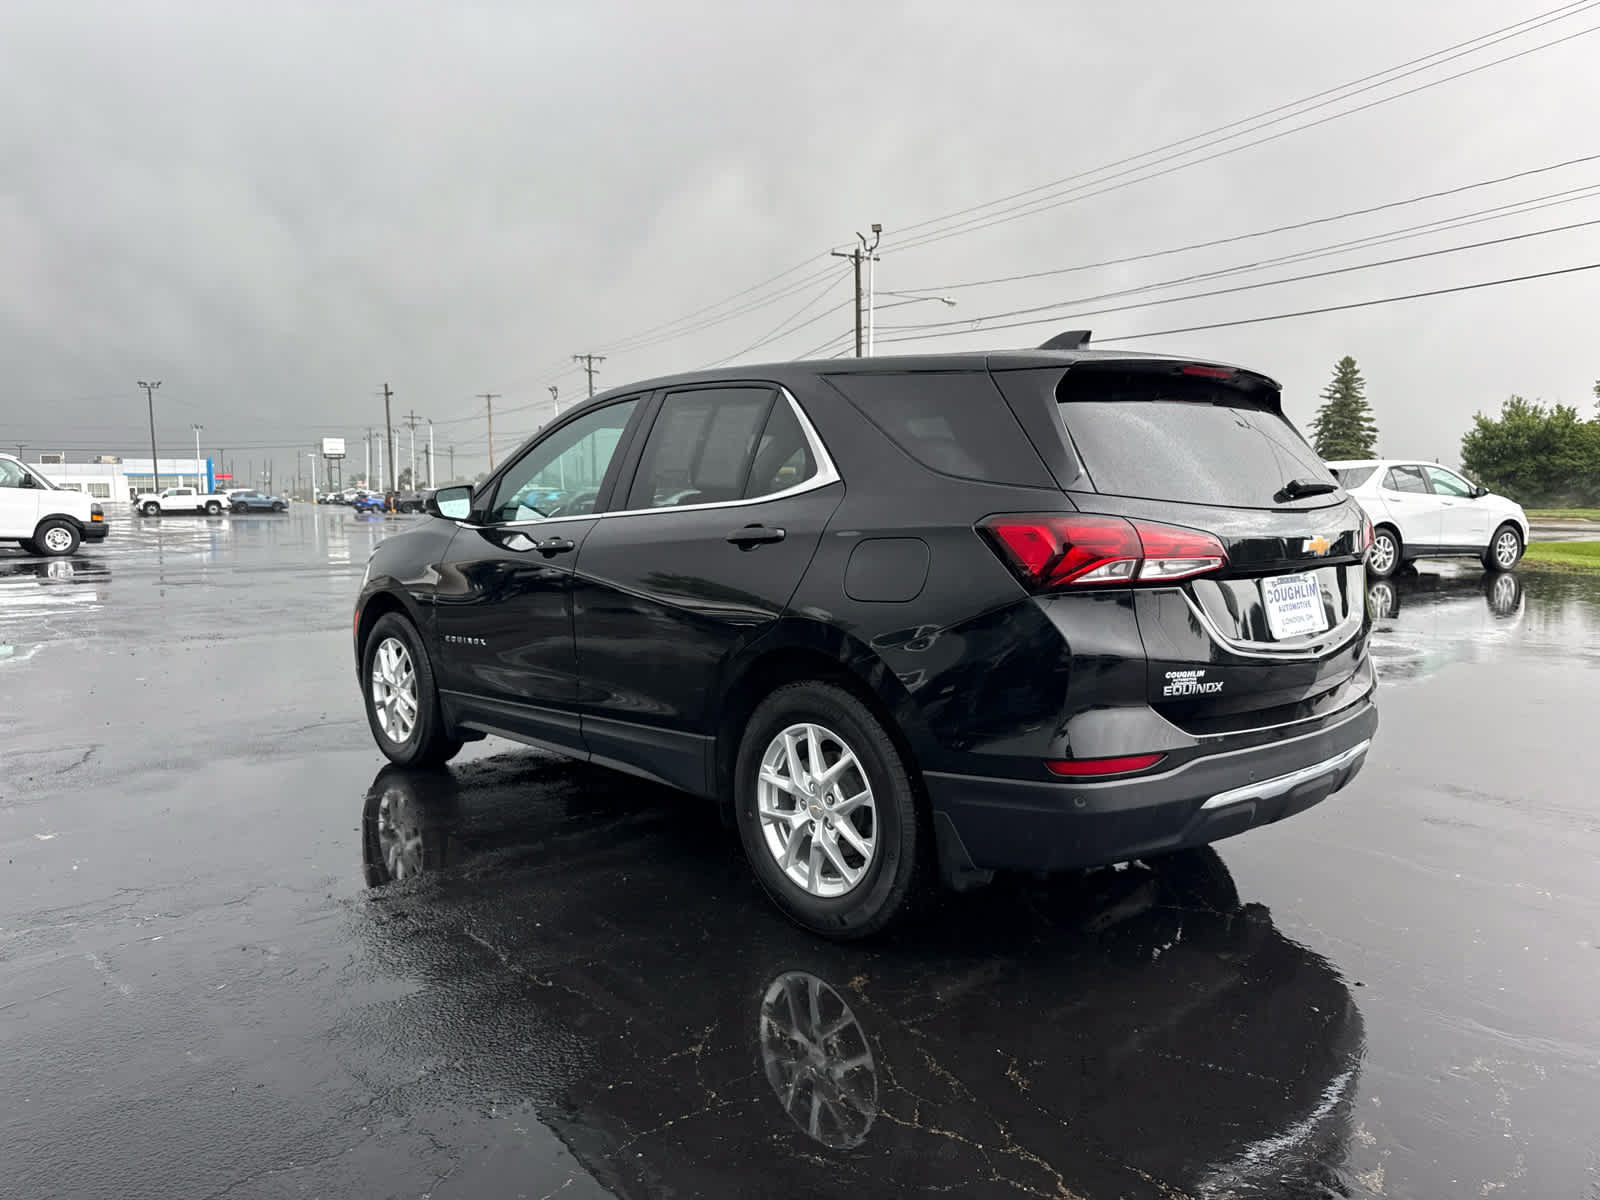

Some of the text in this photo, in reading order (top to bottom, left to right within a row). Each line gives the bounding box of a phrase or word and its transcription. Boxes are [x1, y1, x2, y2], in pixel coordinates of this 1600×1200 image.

[1267, 583, 1317, 603] COUGHLIN
[445, 635, 486, 645] EQUINOX
[1165, 670, 1205, 679] COUGHLIN
[1163, 682, 1224, 696] EQUINOX
